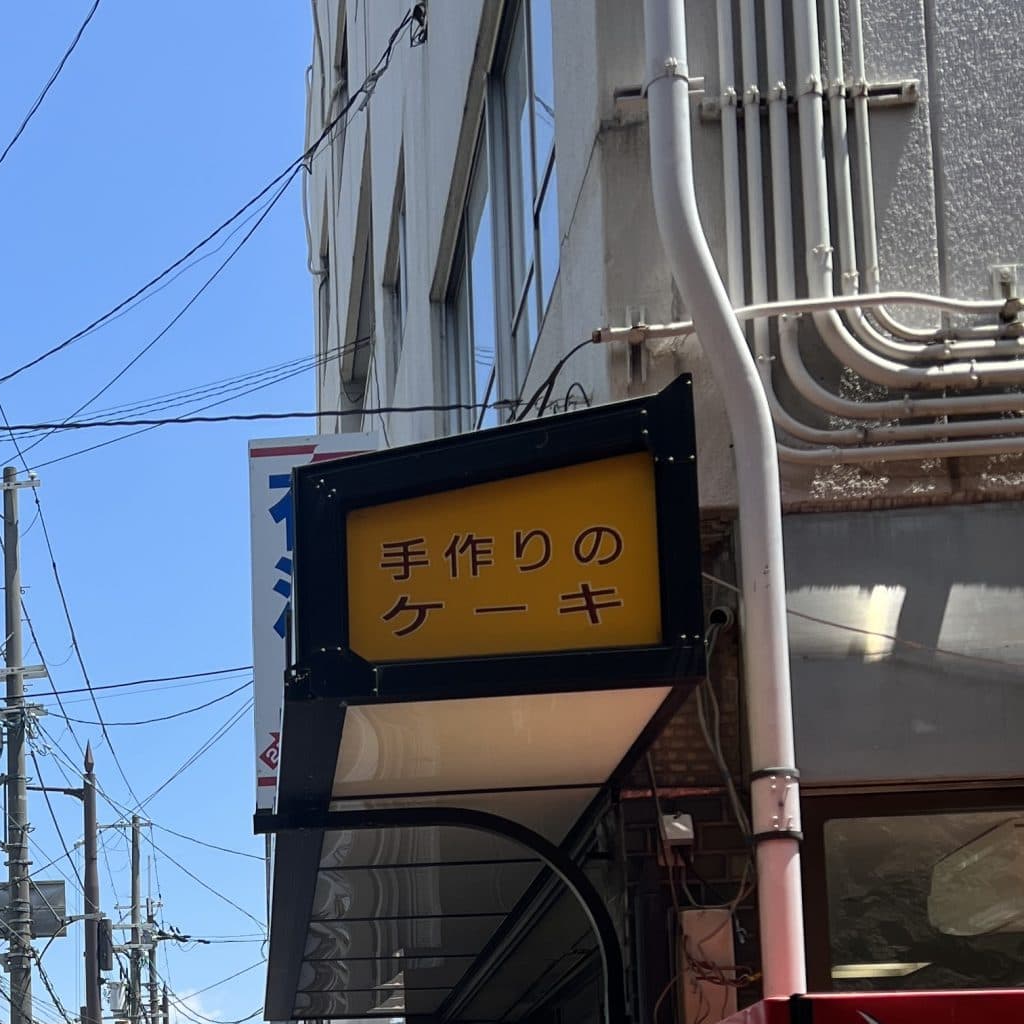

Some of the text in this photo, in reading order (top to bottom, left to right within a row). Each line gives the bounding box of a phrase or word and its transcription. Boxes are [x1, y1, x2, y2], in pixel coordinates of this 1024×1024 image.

[380, 525, 624, 581] 手作りの
[381, 582, 624, 637] ケーキ
